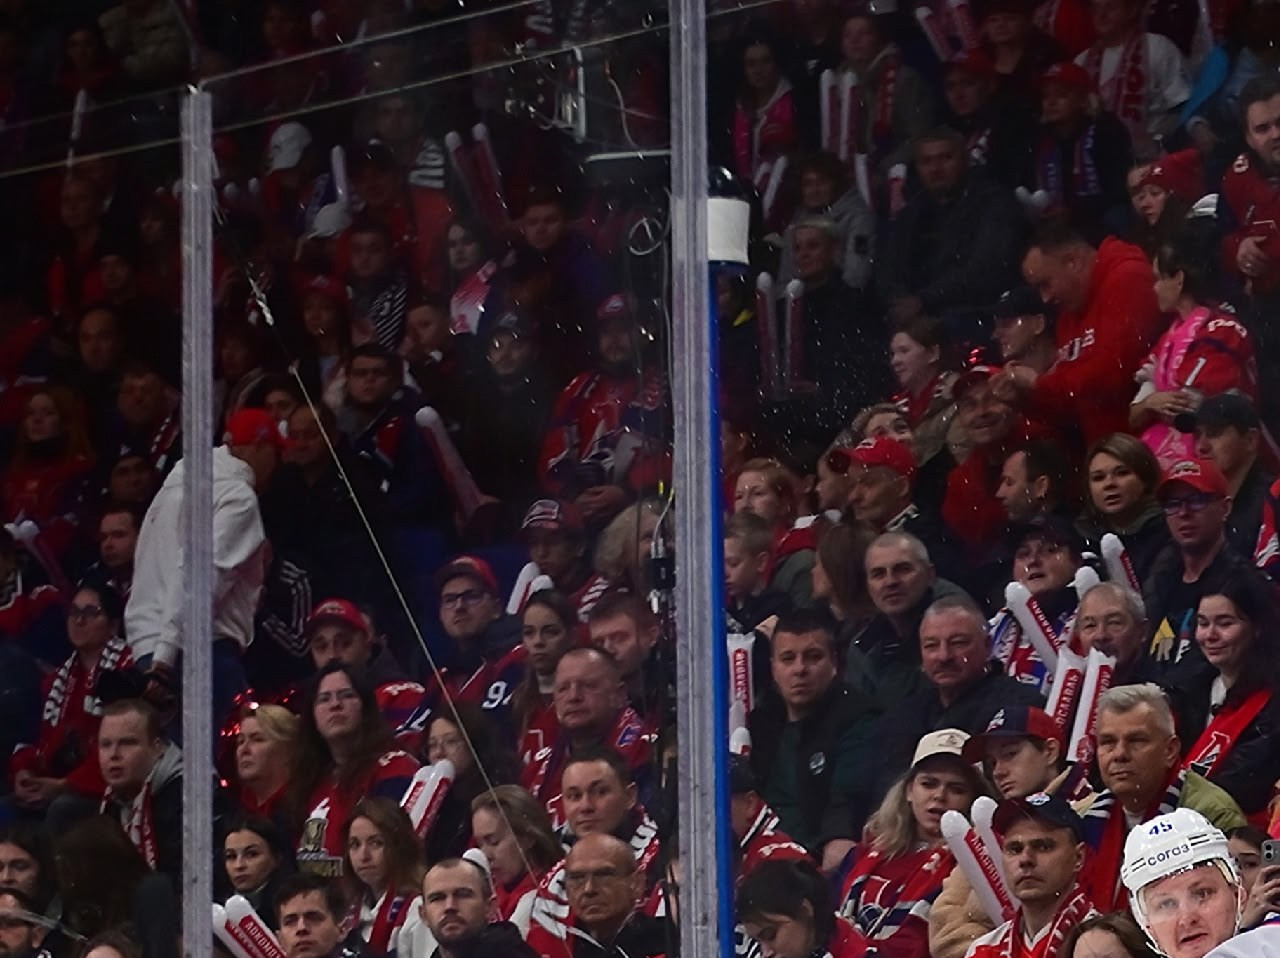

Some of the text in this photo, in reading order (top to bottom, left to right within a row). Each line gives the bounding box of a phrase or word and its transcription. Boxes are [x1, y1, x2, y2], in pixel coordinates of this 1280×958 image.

[1032, 600, 1061, 650] ОСЛАВЛЬ
[1056, 673, 1080, 730] ОСЛАВЛЬ
[1147, 844, 1190, 866] согаз
